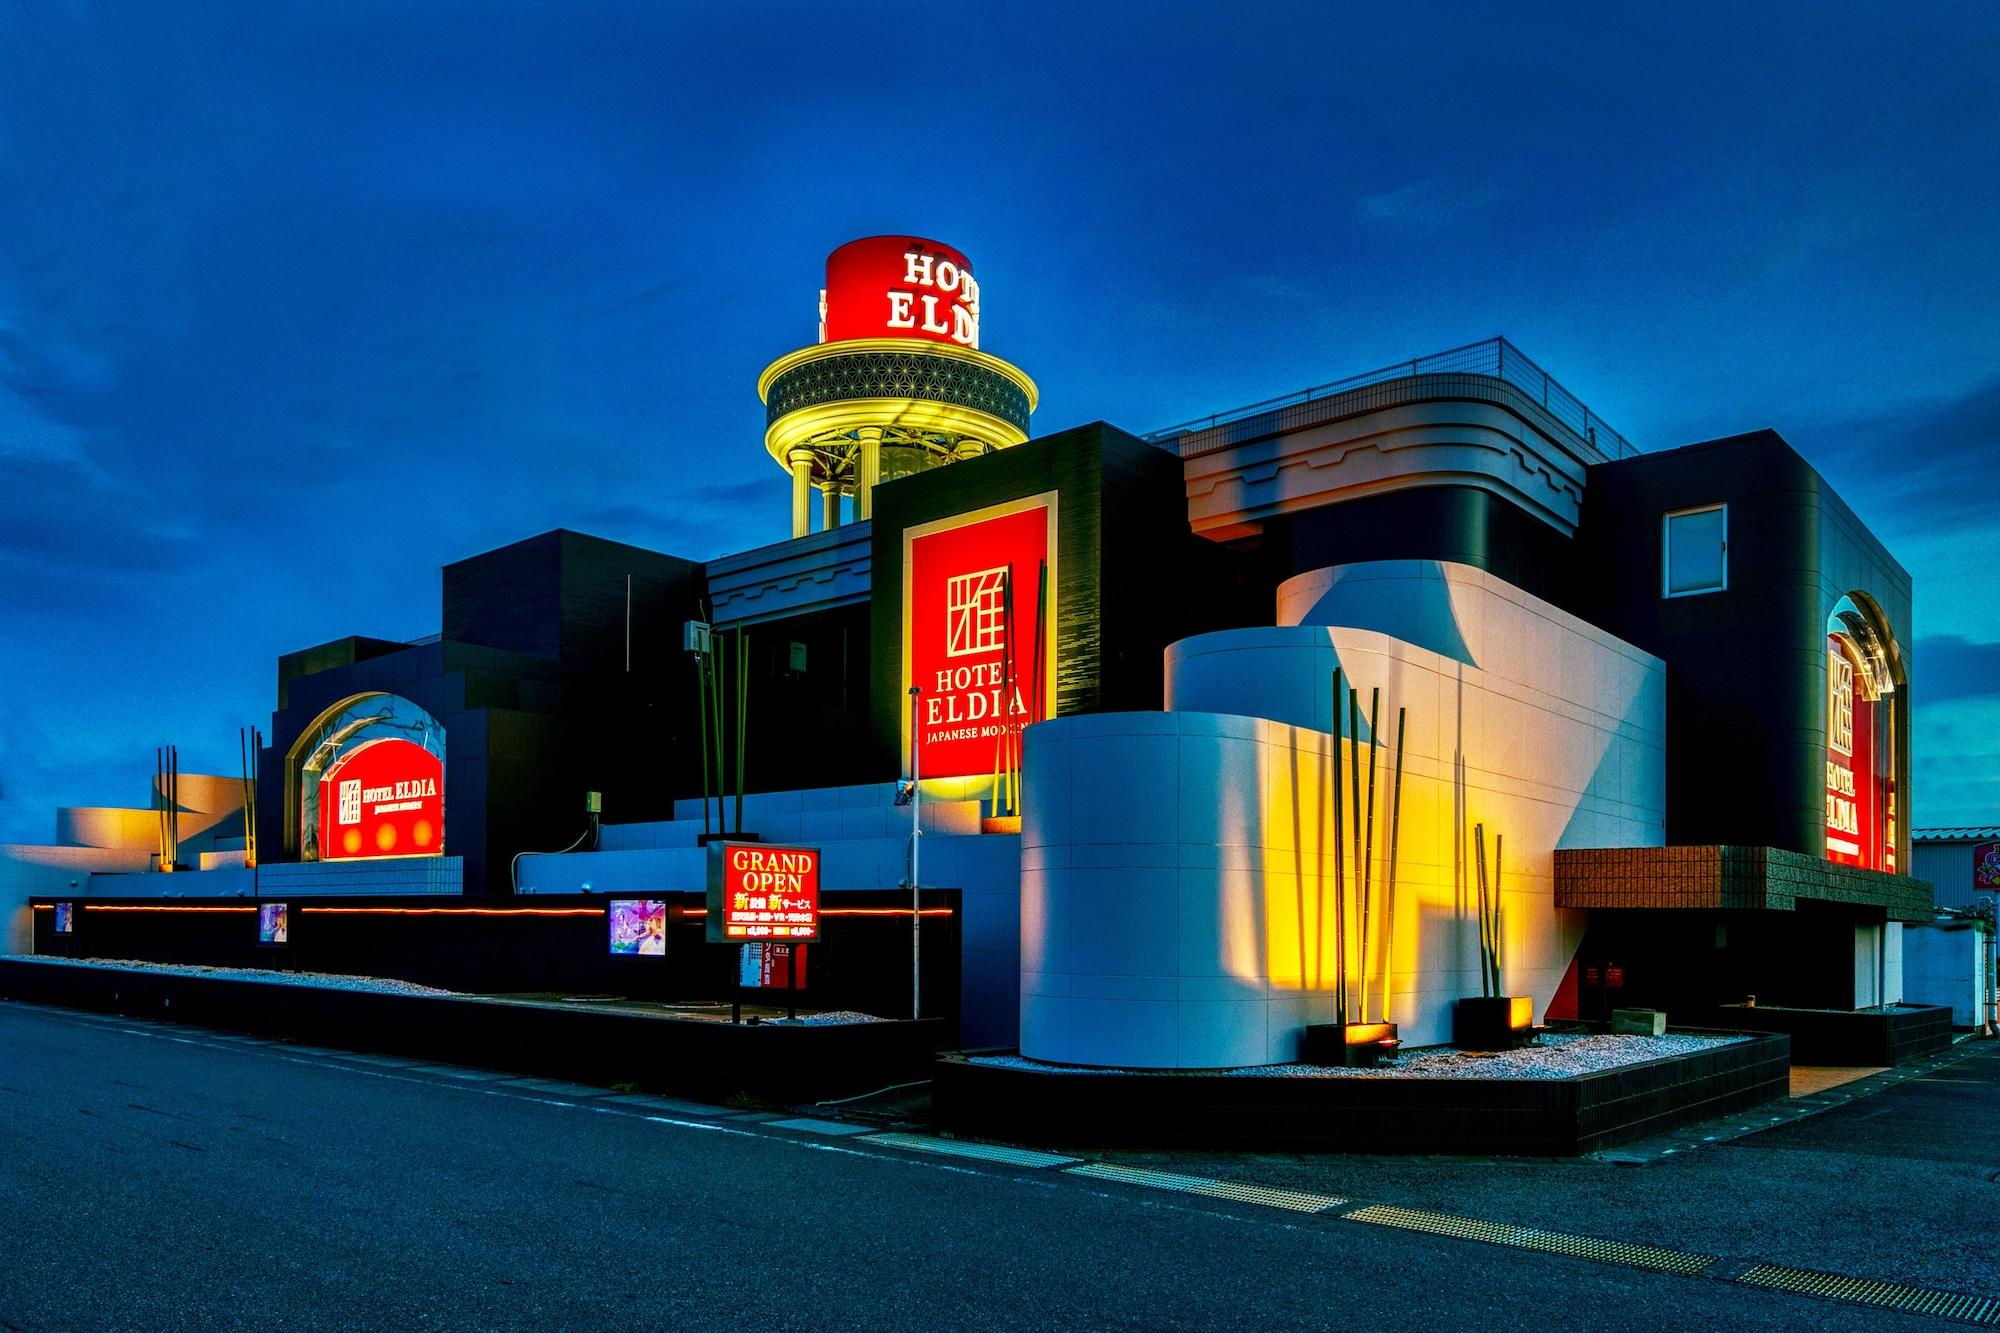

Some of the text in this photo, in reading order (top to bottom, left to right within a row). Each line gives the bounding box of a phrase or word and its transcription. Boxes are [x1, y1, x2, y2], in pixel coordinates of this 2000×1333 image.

[904, 252, 979, 306] HOT
[887, 291, 979, 349] ELD
[926, 686, 1028, 726] ELDIA
[926, 727, 978, 745] JAPANESE
[363, 777, 437, 804] HOTEL ELDIA
[733, 850, 812, 874] GRAND
[742, 871, 802, 893] OPEN
